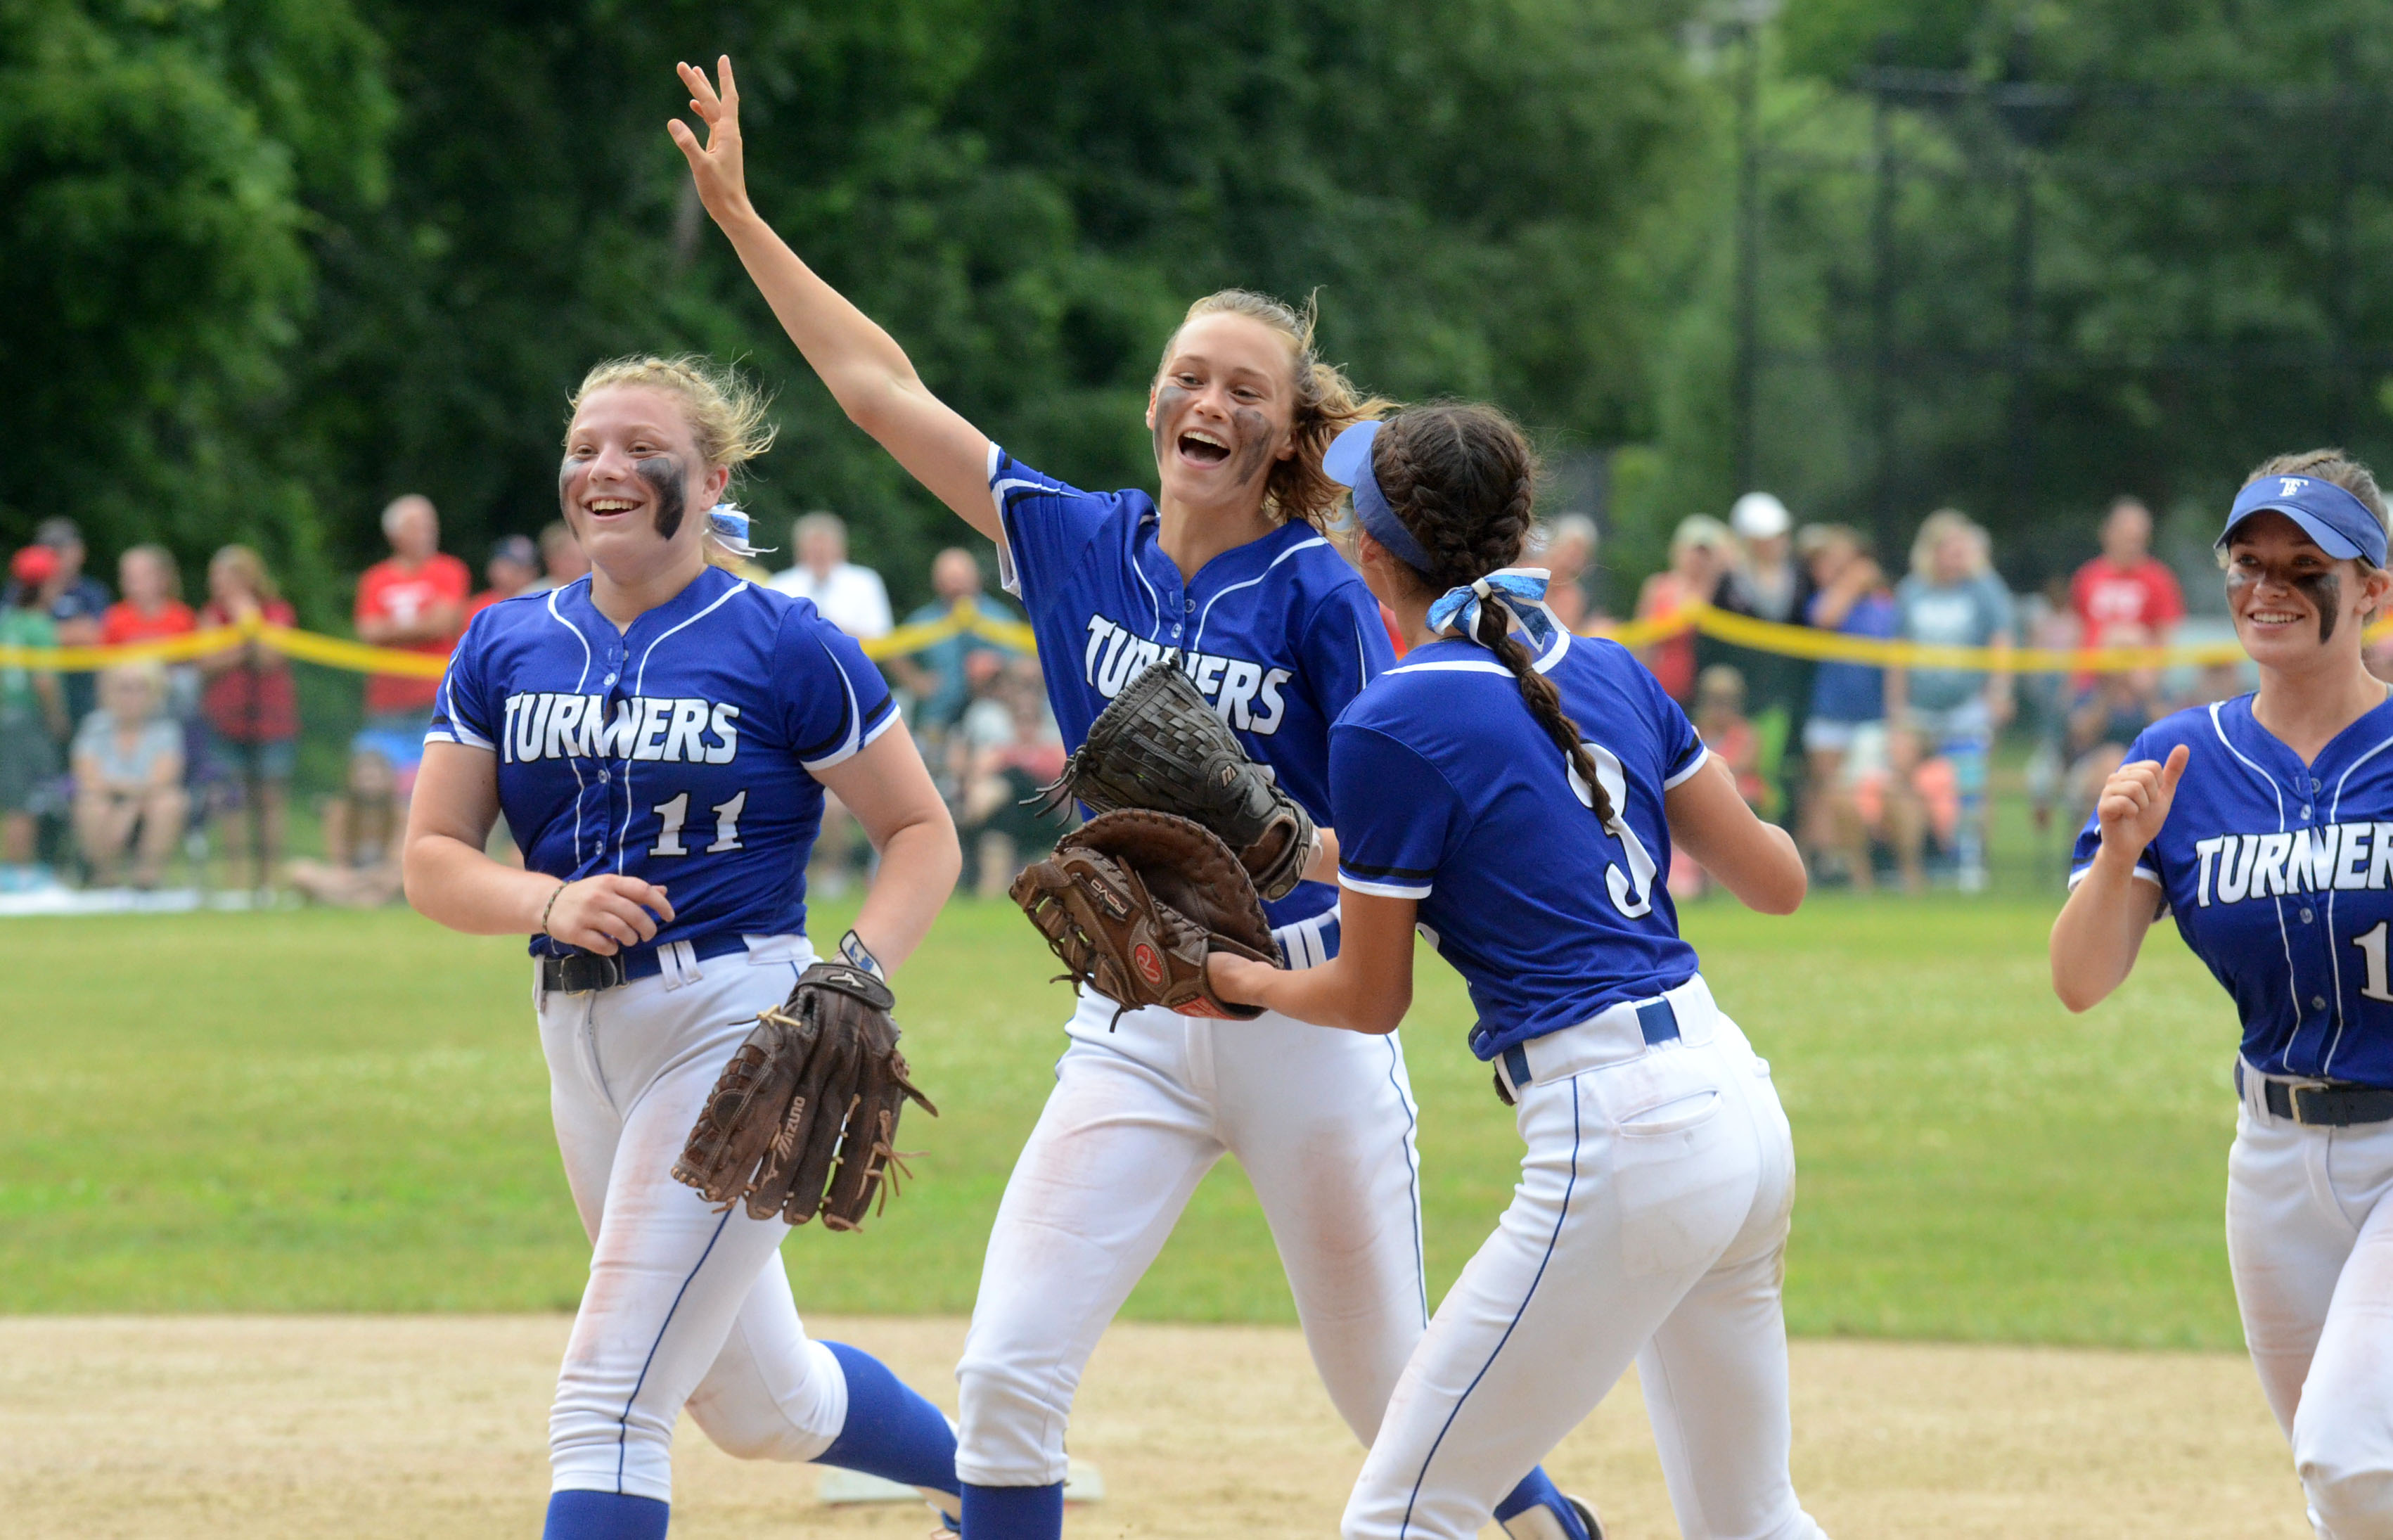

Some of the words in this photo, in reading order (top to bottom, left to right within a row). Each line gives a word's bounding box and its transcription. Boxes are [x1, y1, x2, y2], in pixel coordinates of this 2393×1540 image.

[504, 692, 740, 764] TURNERS
[649, 790, 747, 856] 11
[1566, 742, 1657, 918] 3
